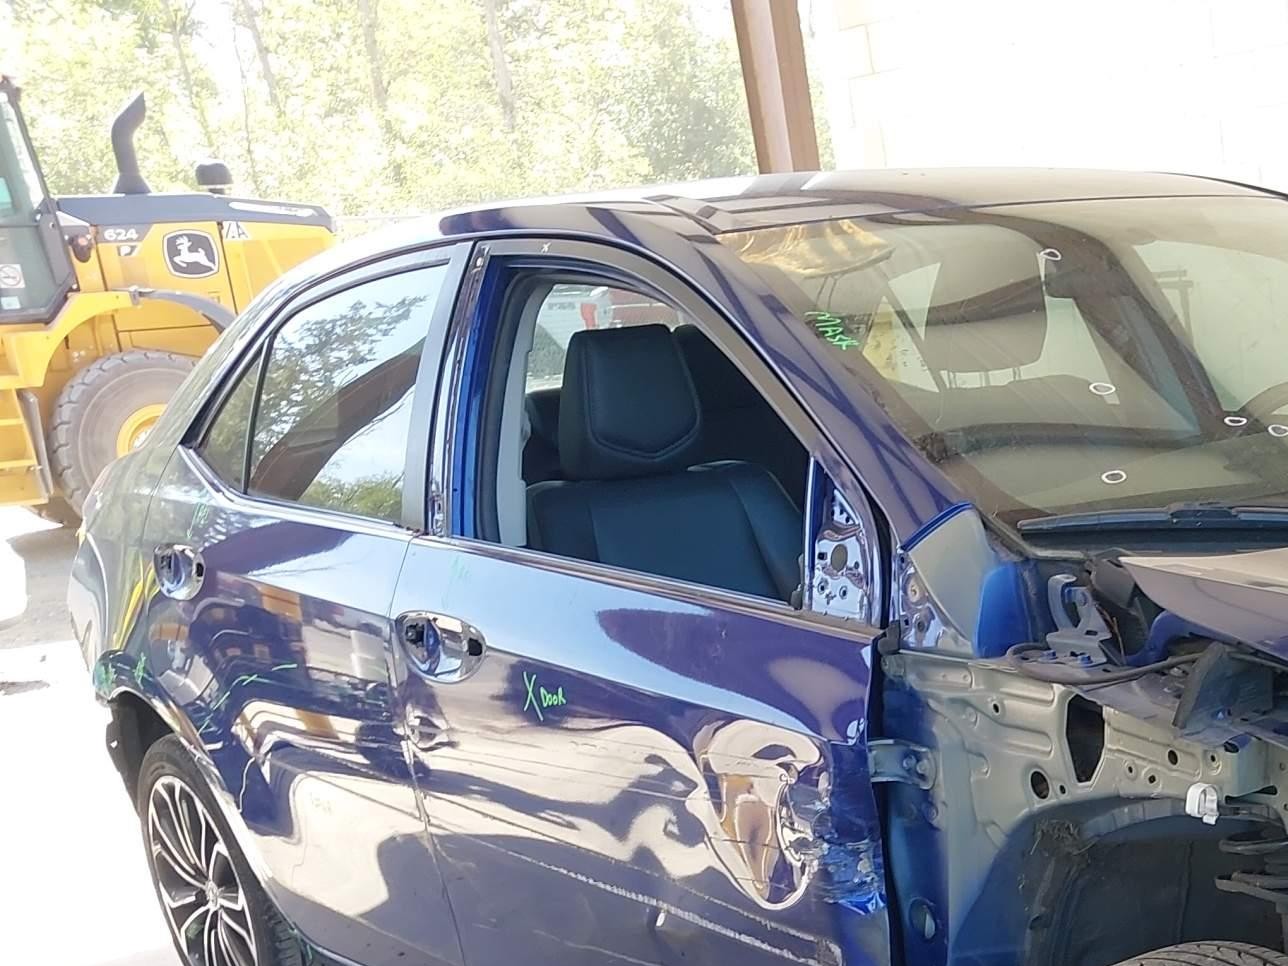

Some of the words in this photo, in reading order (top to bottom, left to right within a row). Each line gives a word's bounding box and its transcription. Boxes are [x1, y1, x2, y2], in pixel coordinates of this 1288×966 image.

[104, 228, 138, 241] 624
[804, 311, 860, 350] MASK
[523, 671, 544, 721] X
